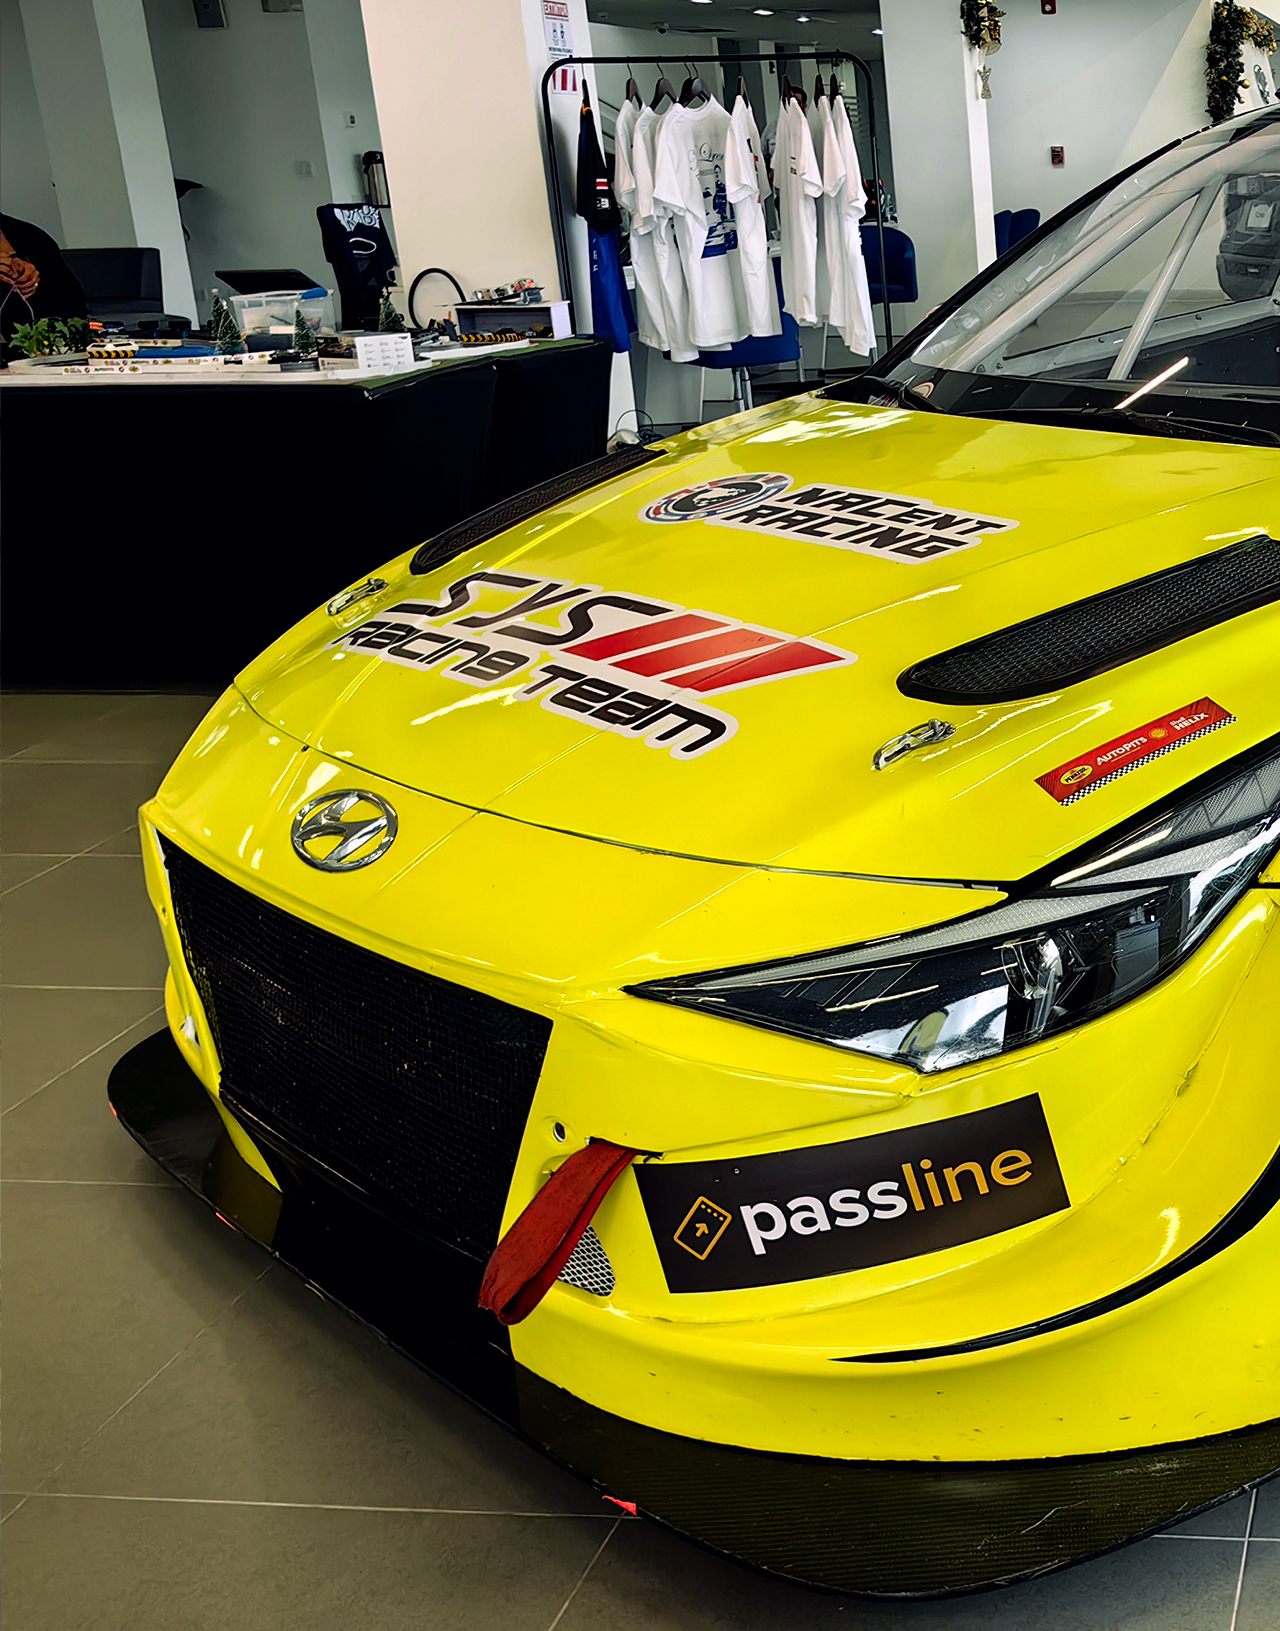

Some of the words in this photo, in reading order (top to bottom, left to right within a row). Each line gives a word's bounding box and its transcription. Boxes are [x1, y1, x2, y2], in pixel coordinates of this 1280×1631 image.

[721, 505, 969, 559] RACING
[777, 487, 1007, 536] NACENT
[380, 572, 677, 646] SYS
[1174, 712, 1210, 730] HELIX
[740, 1149, 1032, 1256] passline
